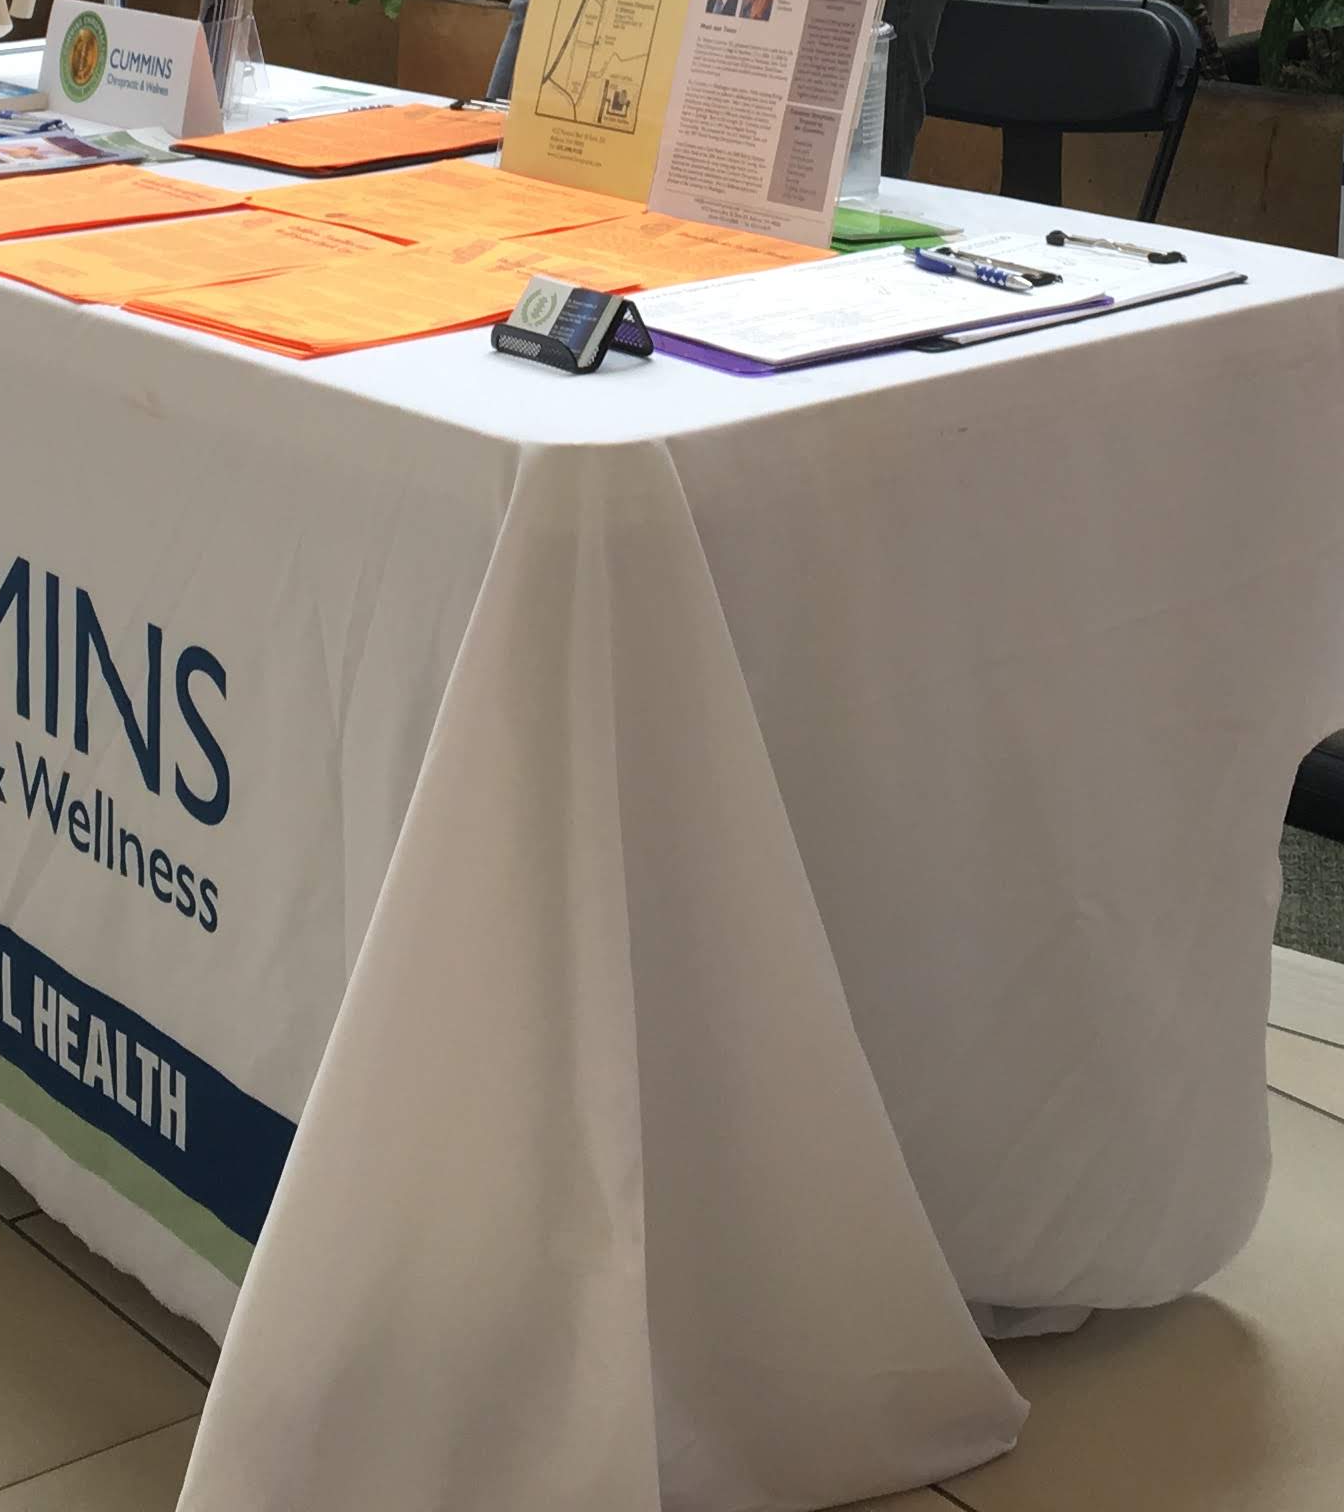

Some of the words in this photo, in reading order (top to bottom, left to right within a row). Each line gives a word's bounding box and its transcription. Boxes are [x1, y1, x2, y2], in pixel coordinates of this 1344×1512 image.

[109, 48, 173, 79] CUMMINS
[17, 739, 220, 933] Wellness
[32, 972, 188, 1152] HEALTH
